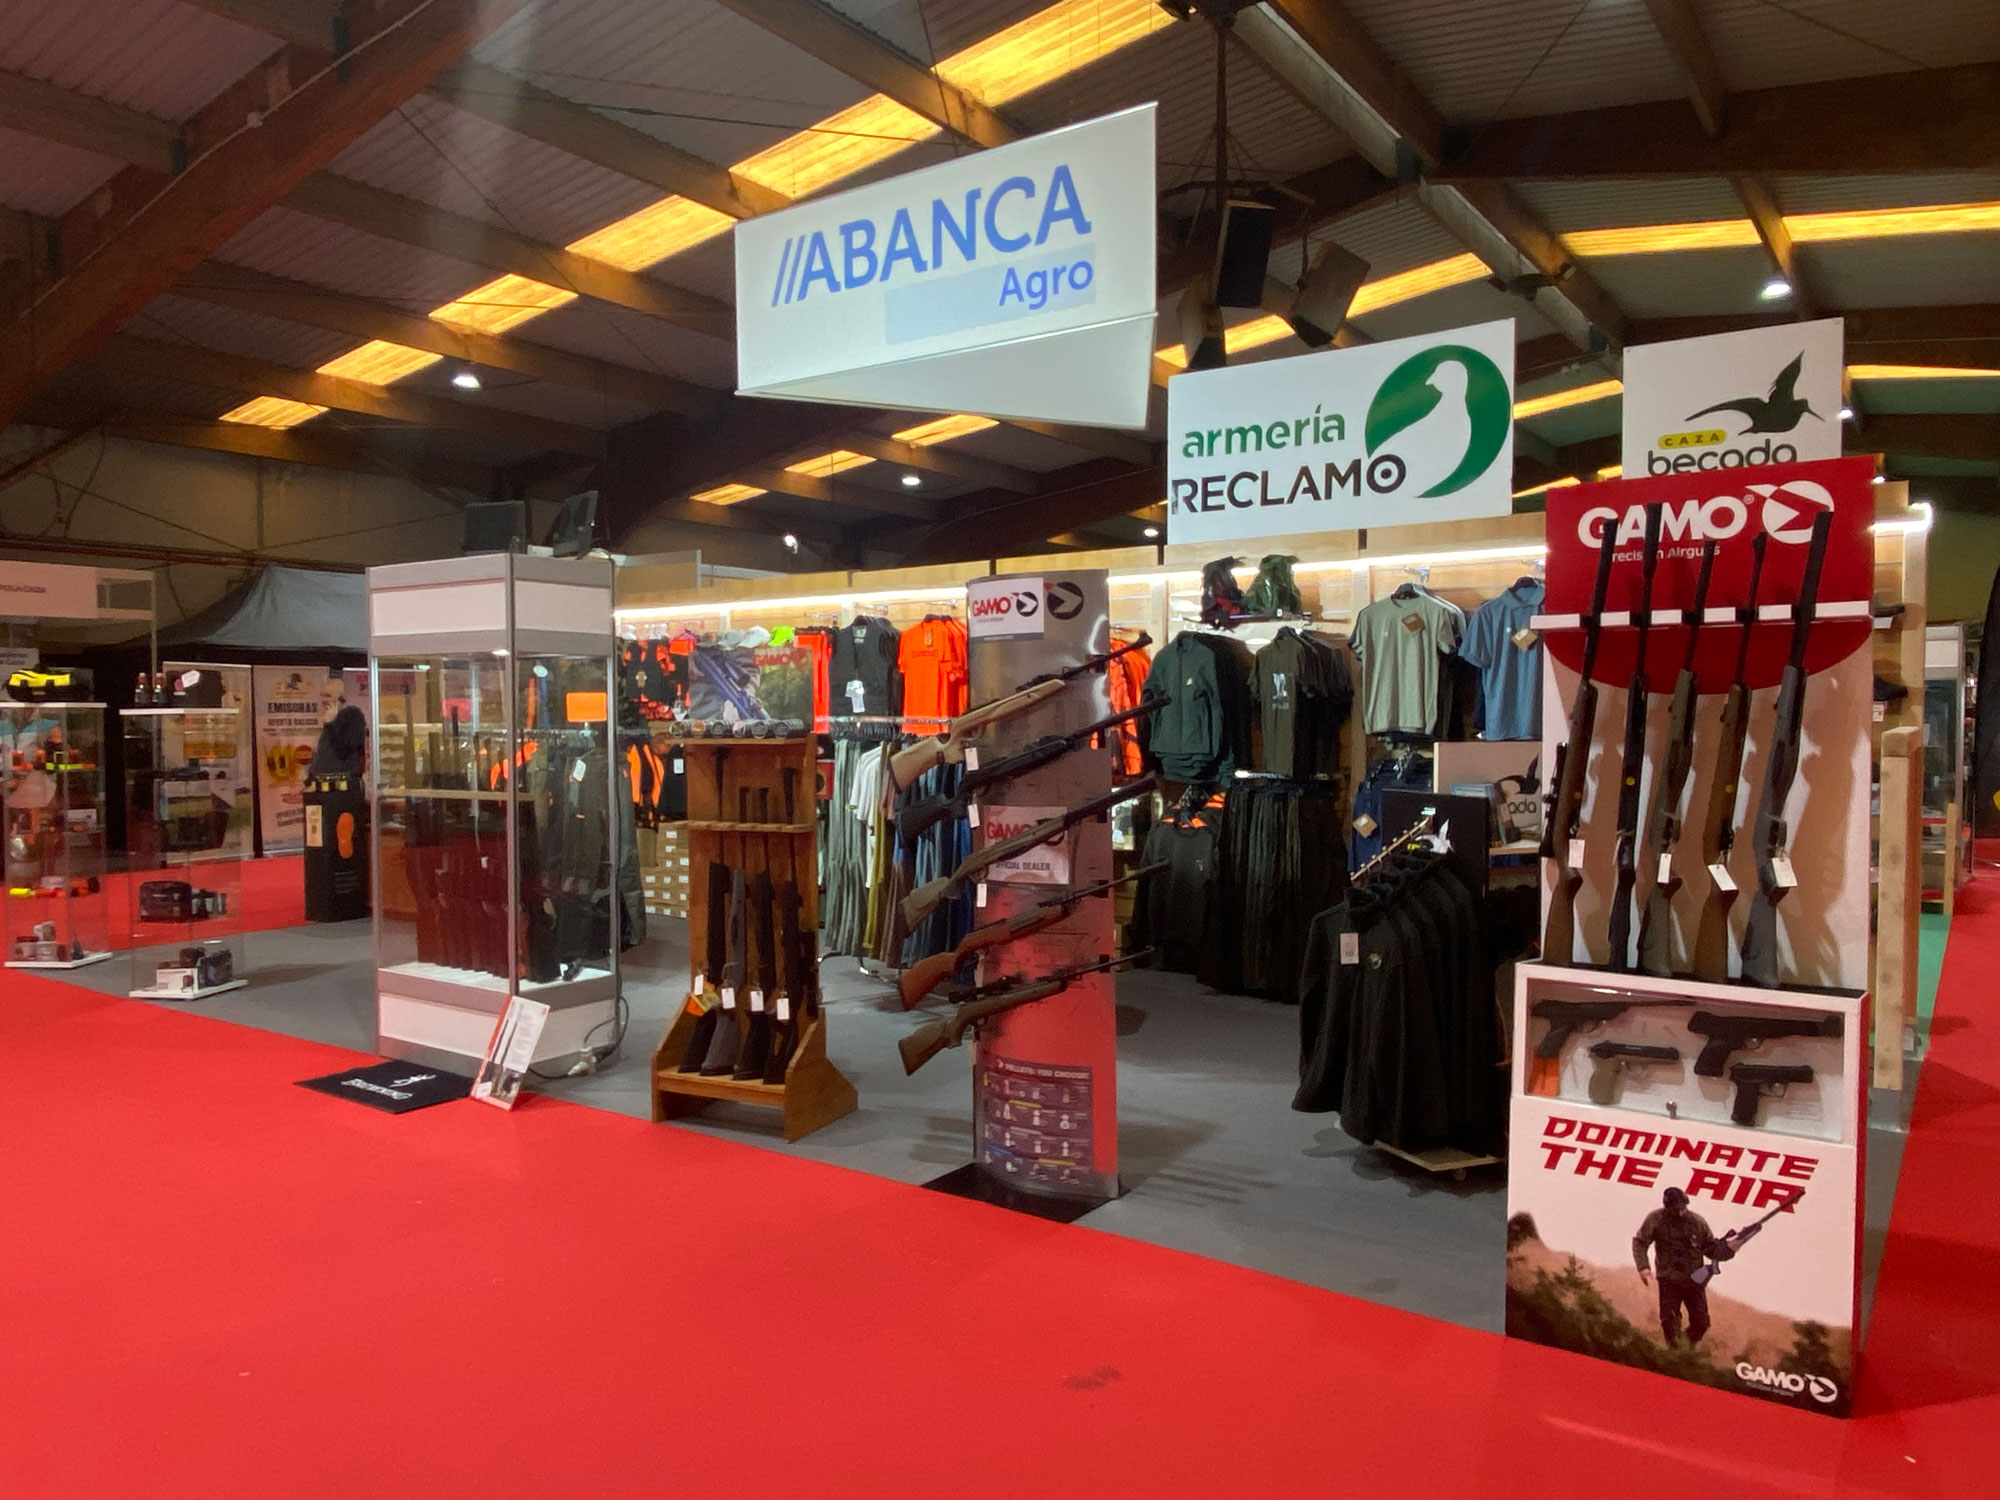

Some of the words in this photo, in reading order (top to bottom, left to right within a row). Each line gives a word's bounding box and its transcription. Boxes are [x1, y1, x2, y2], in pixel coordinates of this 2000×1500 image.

[797, 165, 1092, 301] ABANCA
[998, 261, 1093, 310] Agro
[1182, 404, 1346, 458] armería
[1664, 432, 1720, 447] CAZA
[1171, 453, 1407, 515] RECLAMO
[1578, 495, 1748, 549] GAMO
[1667, 545, 1721, 559] Airgus
[972, 596, 1011, 617] GAMO
[1022, 862, 1051, 871] DEALER
[1542, 1116, 1819, 1180] DOMINATE
[1540, 1142, 1664, 1188] THE
[1685, 1167, 1807, 1214] AIR
[1736, 1362, 1805, 1392] GAMO
